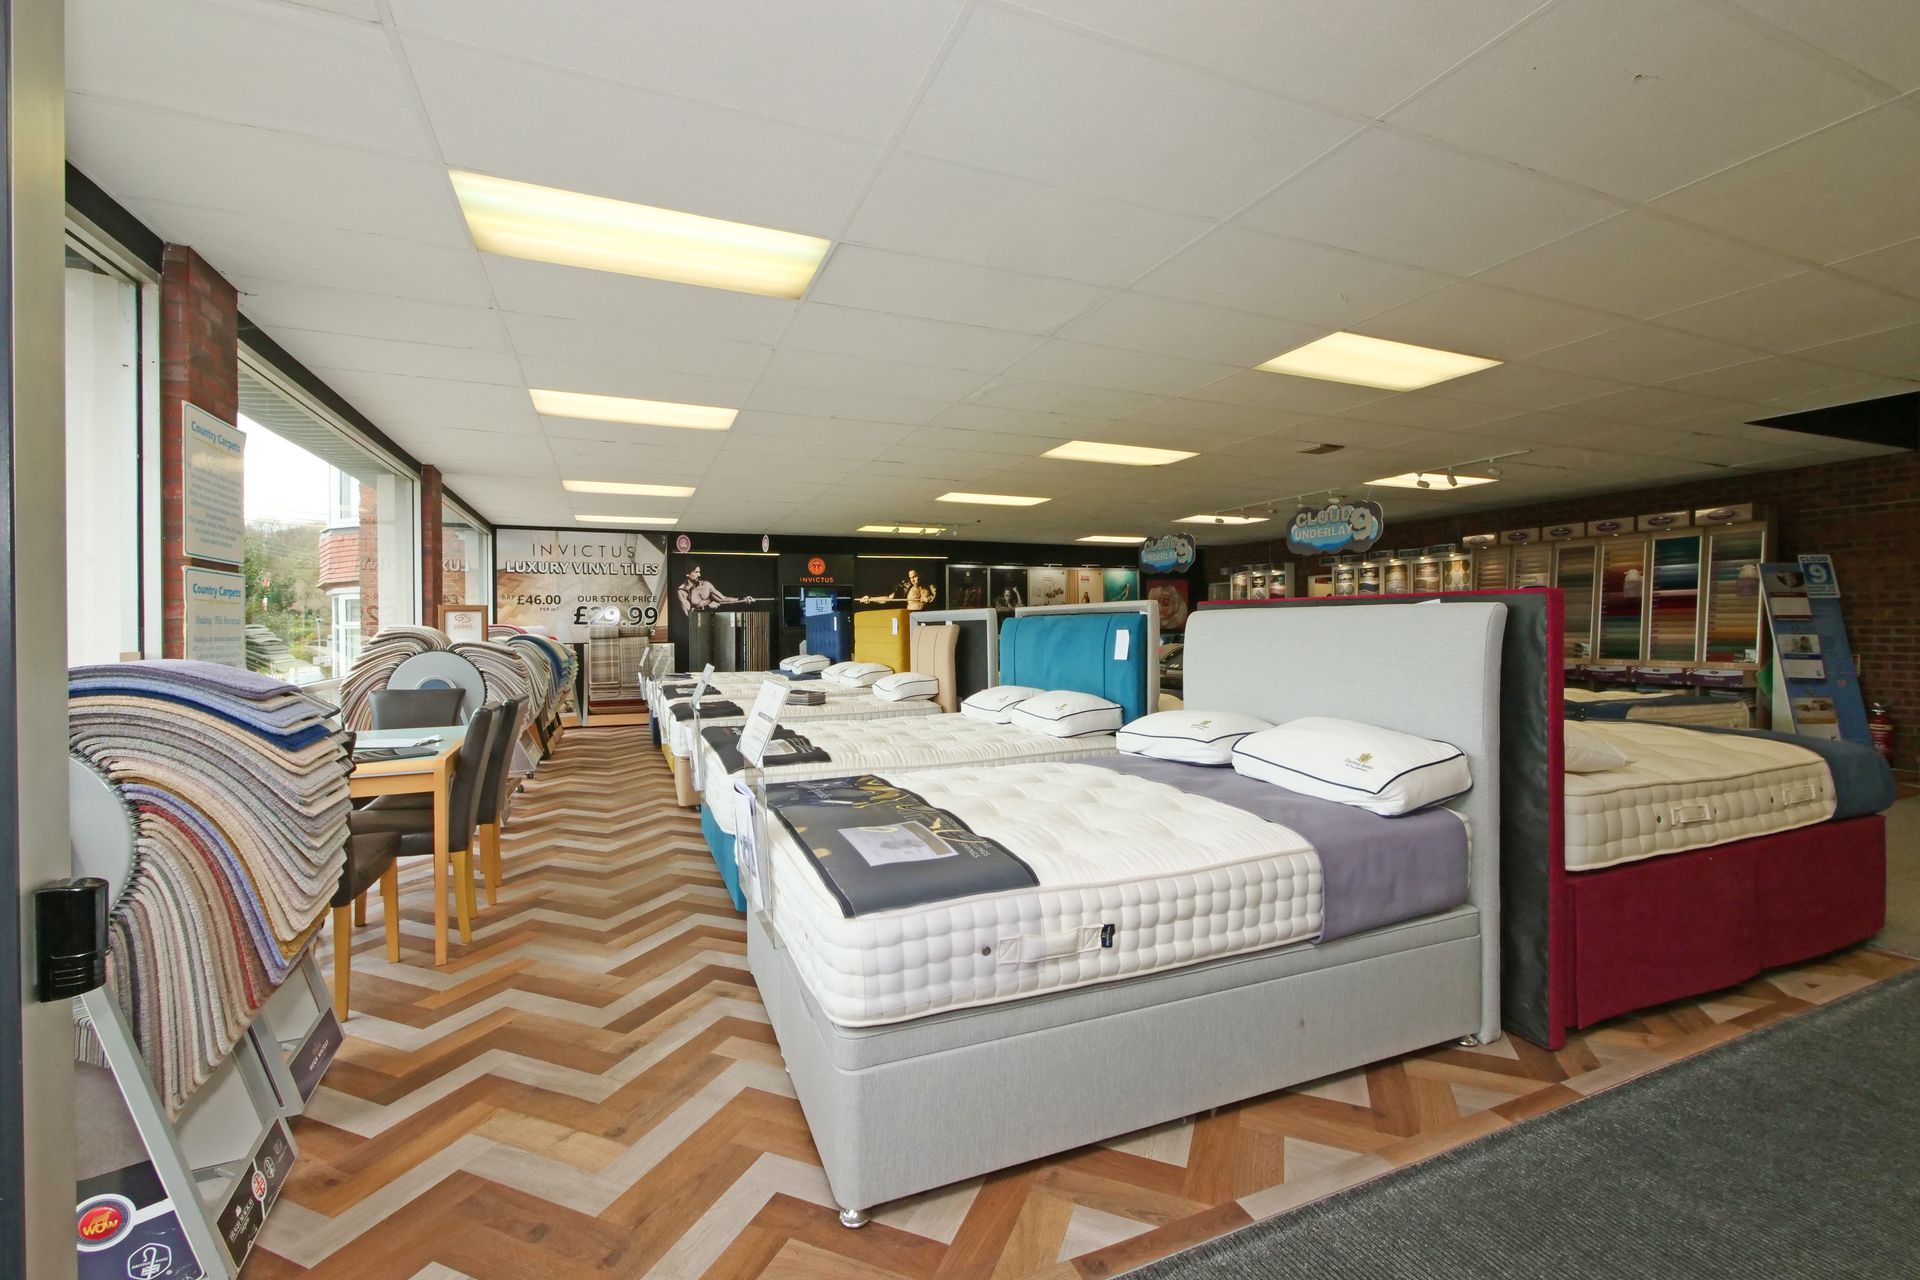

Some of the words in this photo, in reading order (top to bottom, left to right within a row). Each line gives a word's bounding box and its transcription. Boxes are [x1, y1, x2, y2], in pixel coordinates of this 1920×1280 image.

[191, 421, 217, 443] Country
[217, 434, 241, 453] Carpets
[1296, 505, 1353, 527] CLOUD
[1349, 506, 1372, 541] 9
[1295, 525, 1352, 540] UNDERLAY
[532, 544, 636, 558] INVICTUS
[1144, 535, 1178, 552] CLOUD
[1142, 550, 1177, 561] UNDERLAY
[506, 560, 571, 574] LUXURY
[572, 562, 618, 575] VINYL
[621, 563, 660, 576] TILES
[1808, 563, 1828, 584] 9
[192, 583, 218, 599] Country
[218, 586, 241, 600] Carpets
[517, 594, 561, 605] £46.00
[577, 595, 598, 603] OUR
[601, 595, 630, 603] STOCK
[573, 606, 658, 626] £29.99
[82, 1219, 119, 1236] WOW
